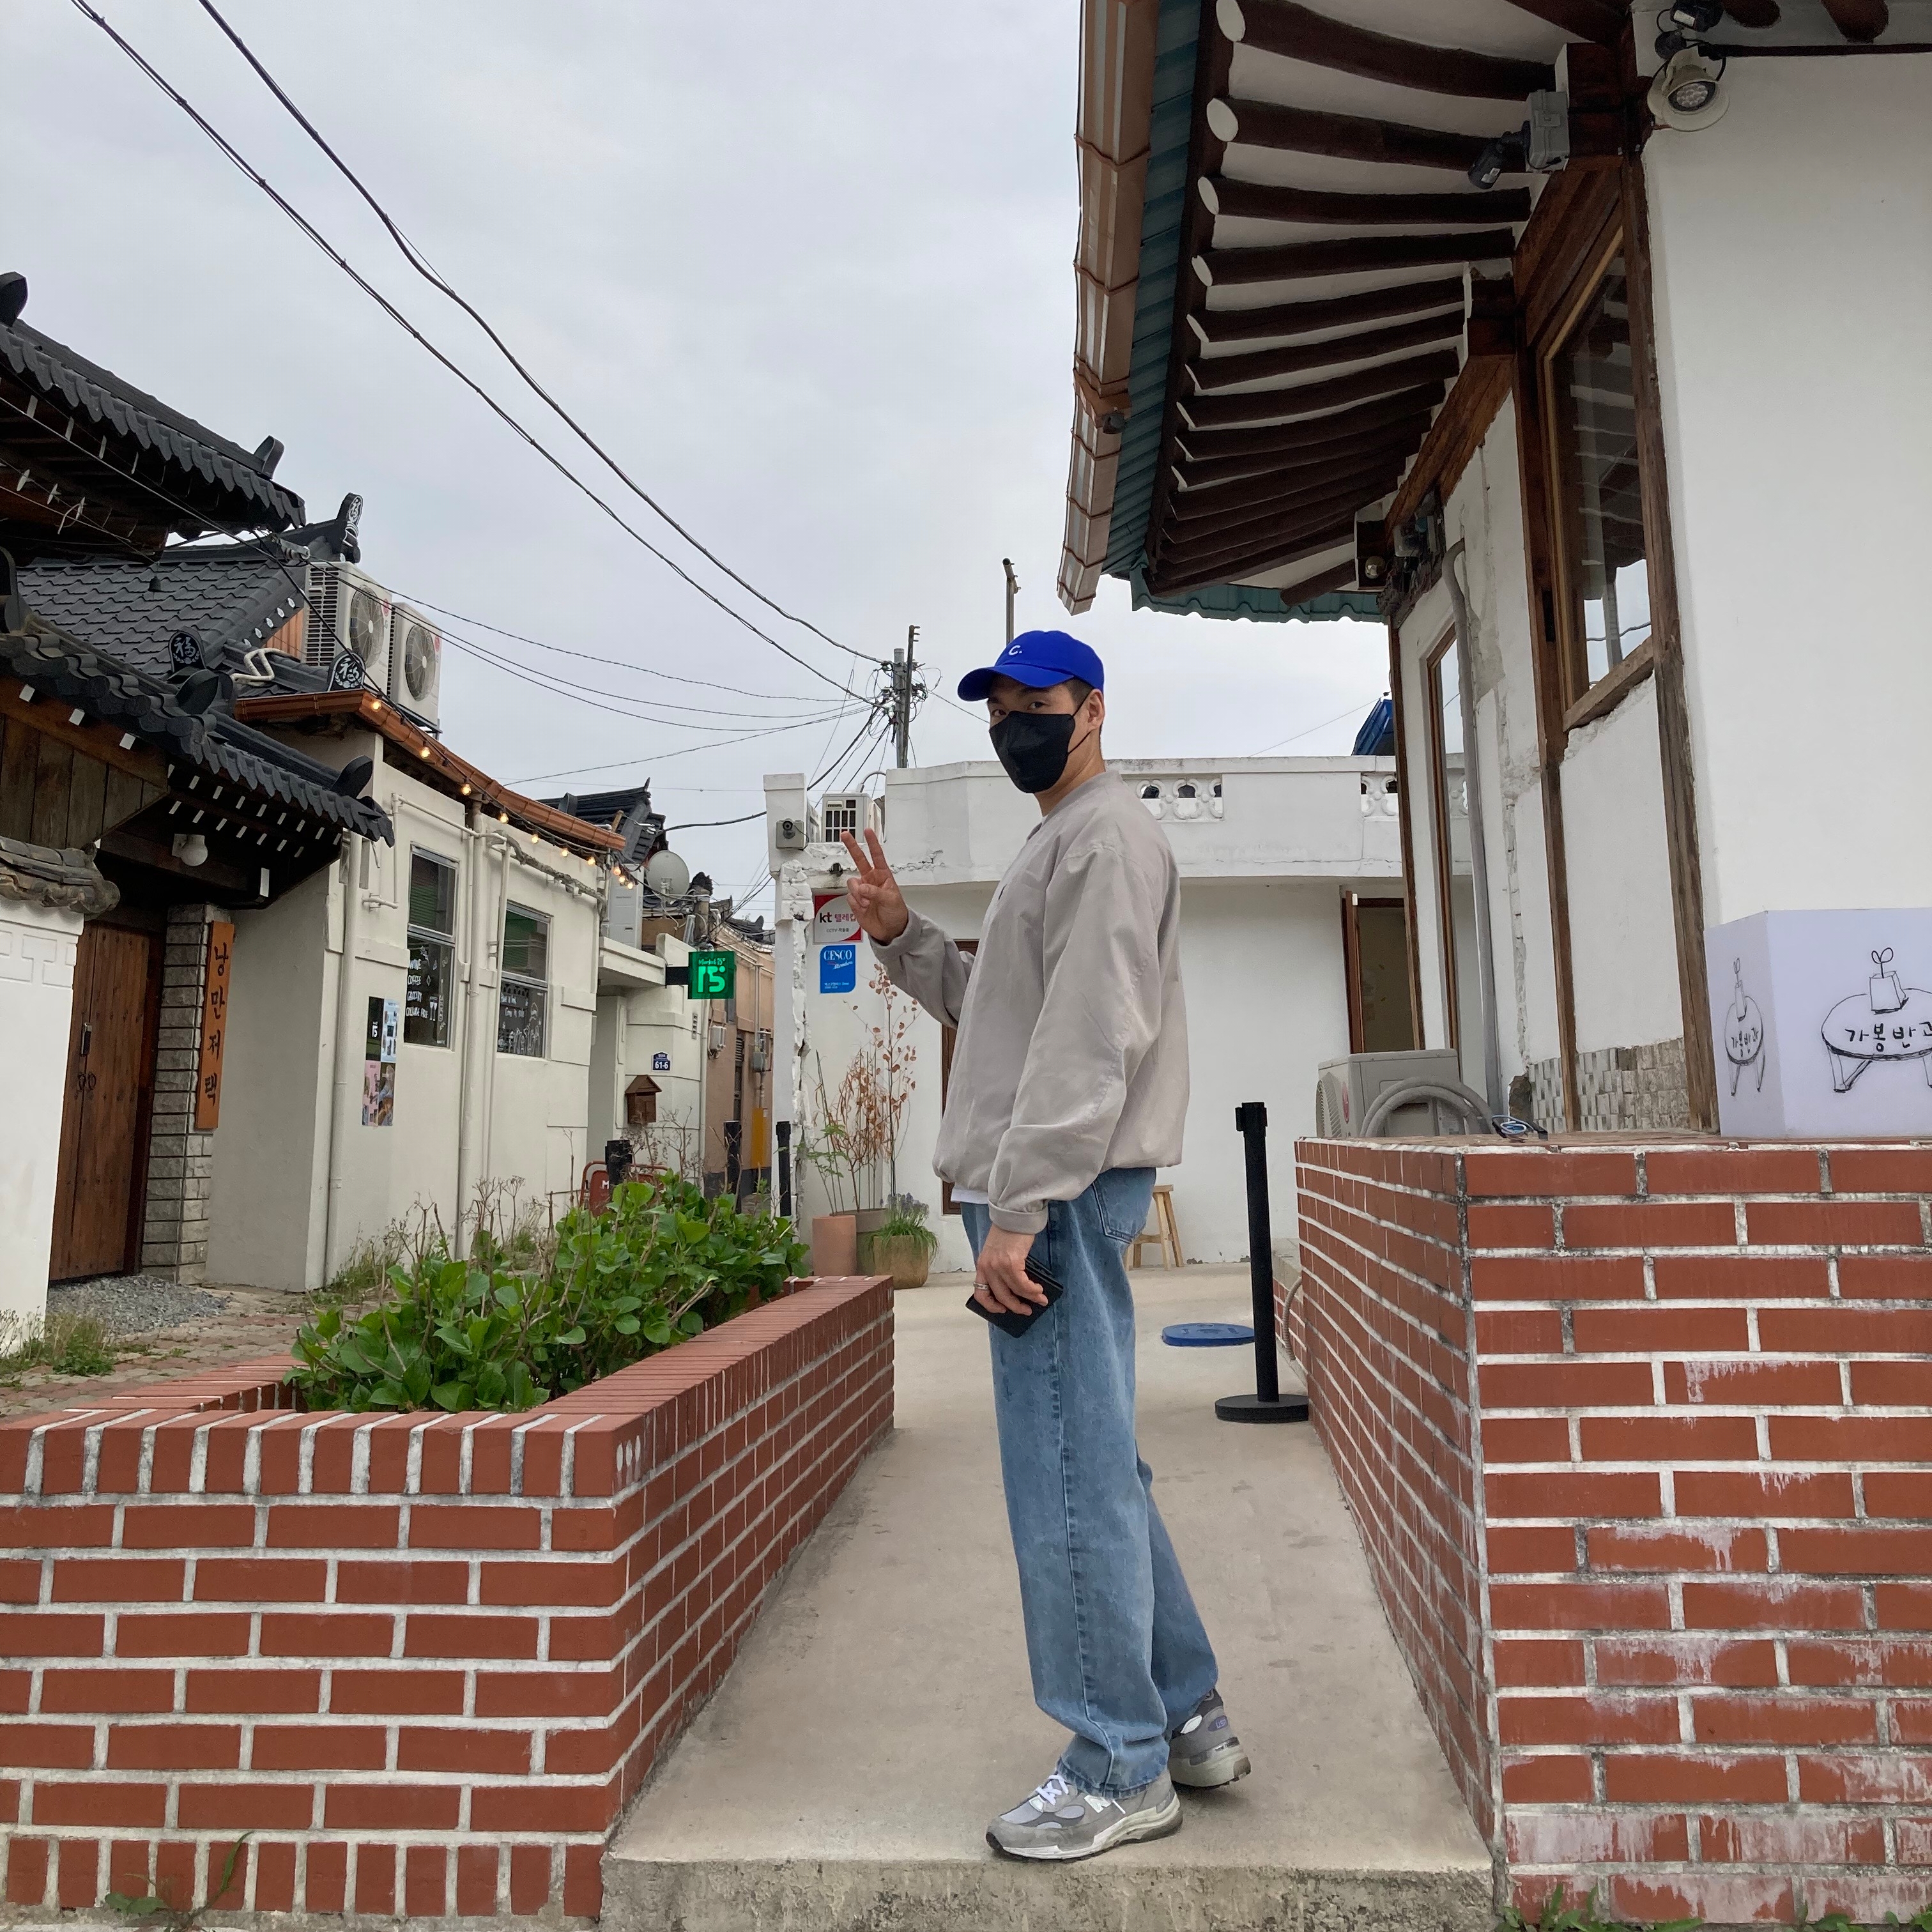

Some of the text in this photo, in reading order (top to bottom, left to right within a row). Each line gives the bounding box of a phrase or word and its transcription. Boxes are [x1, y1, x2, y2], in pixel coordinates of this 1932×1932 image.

[820, 912, 832, 923] kt
[824, 949, 852, 961] CESCO
[410, 958, 422, 970] WINE
[408, 975, 422, 986] COFFEE
[204, 942, 228, 1107] 낭만저택
